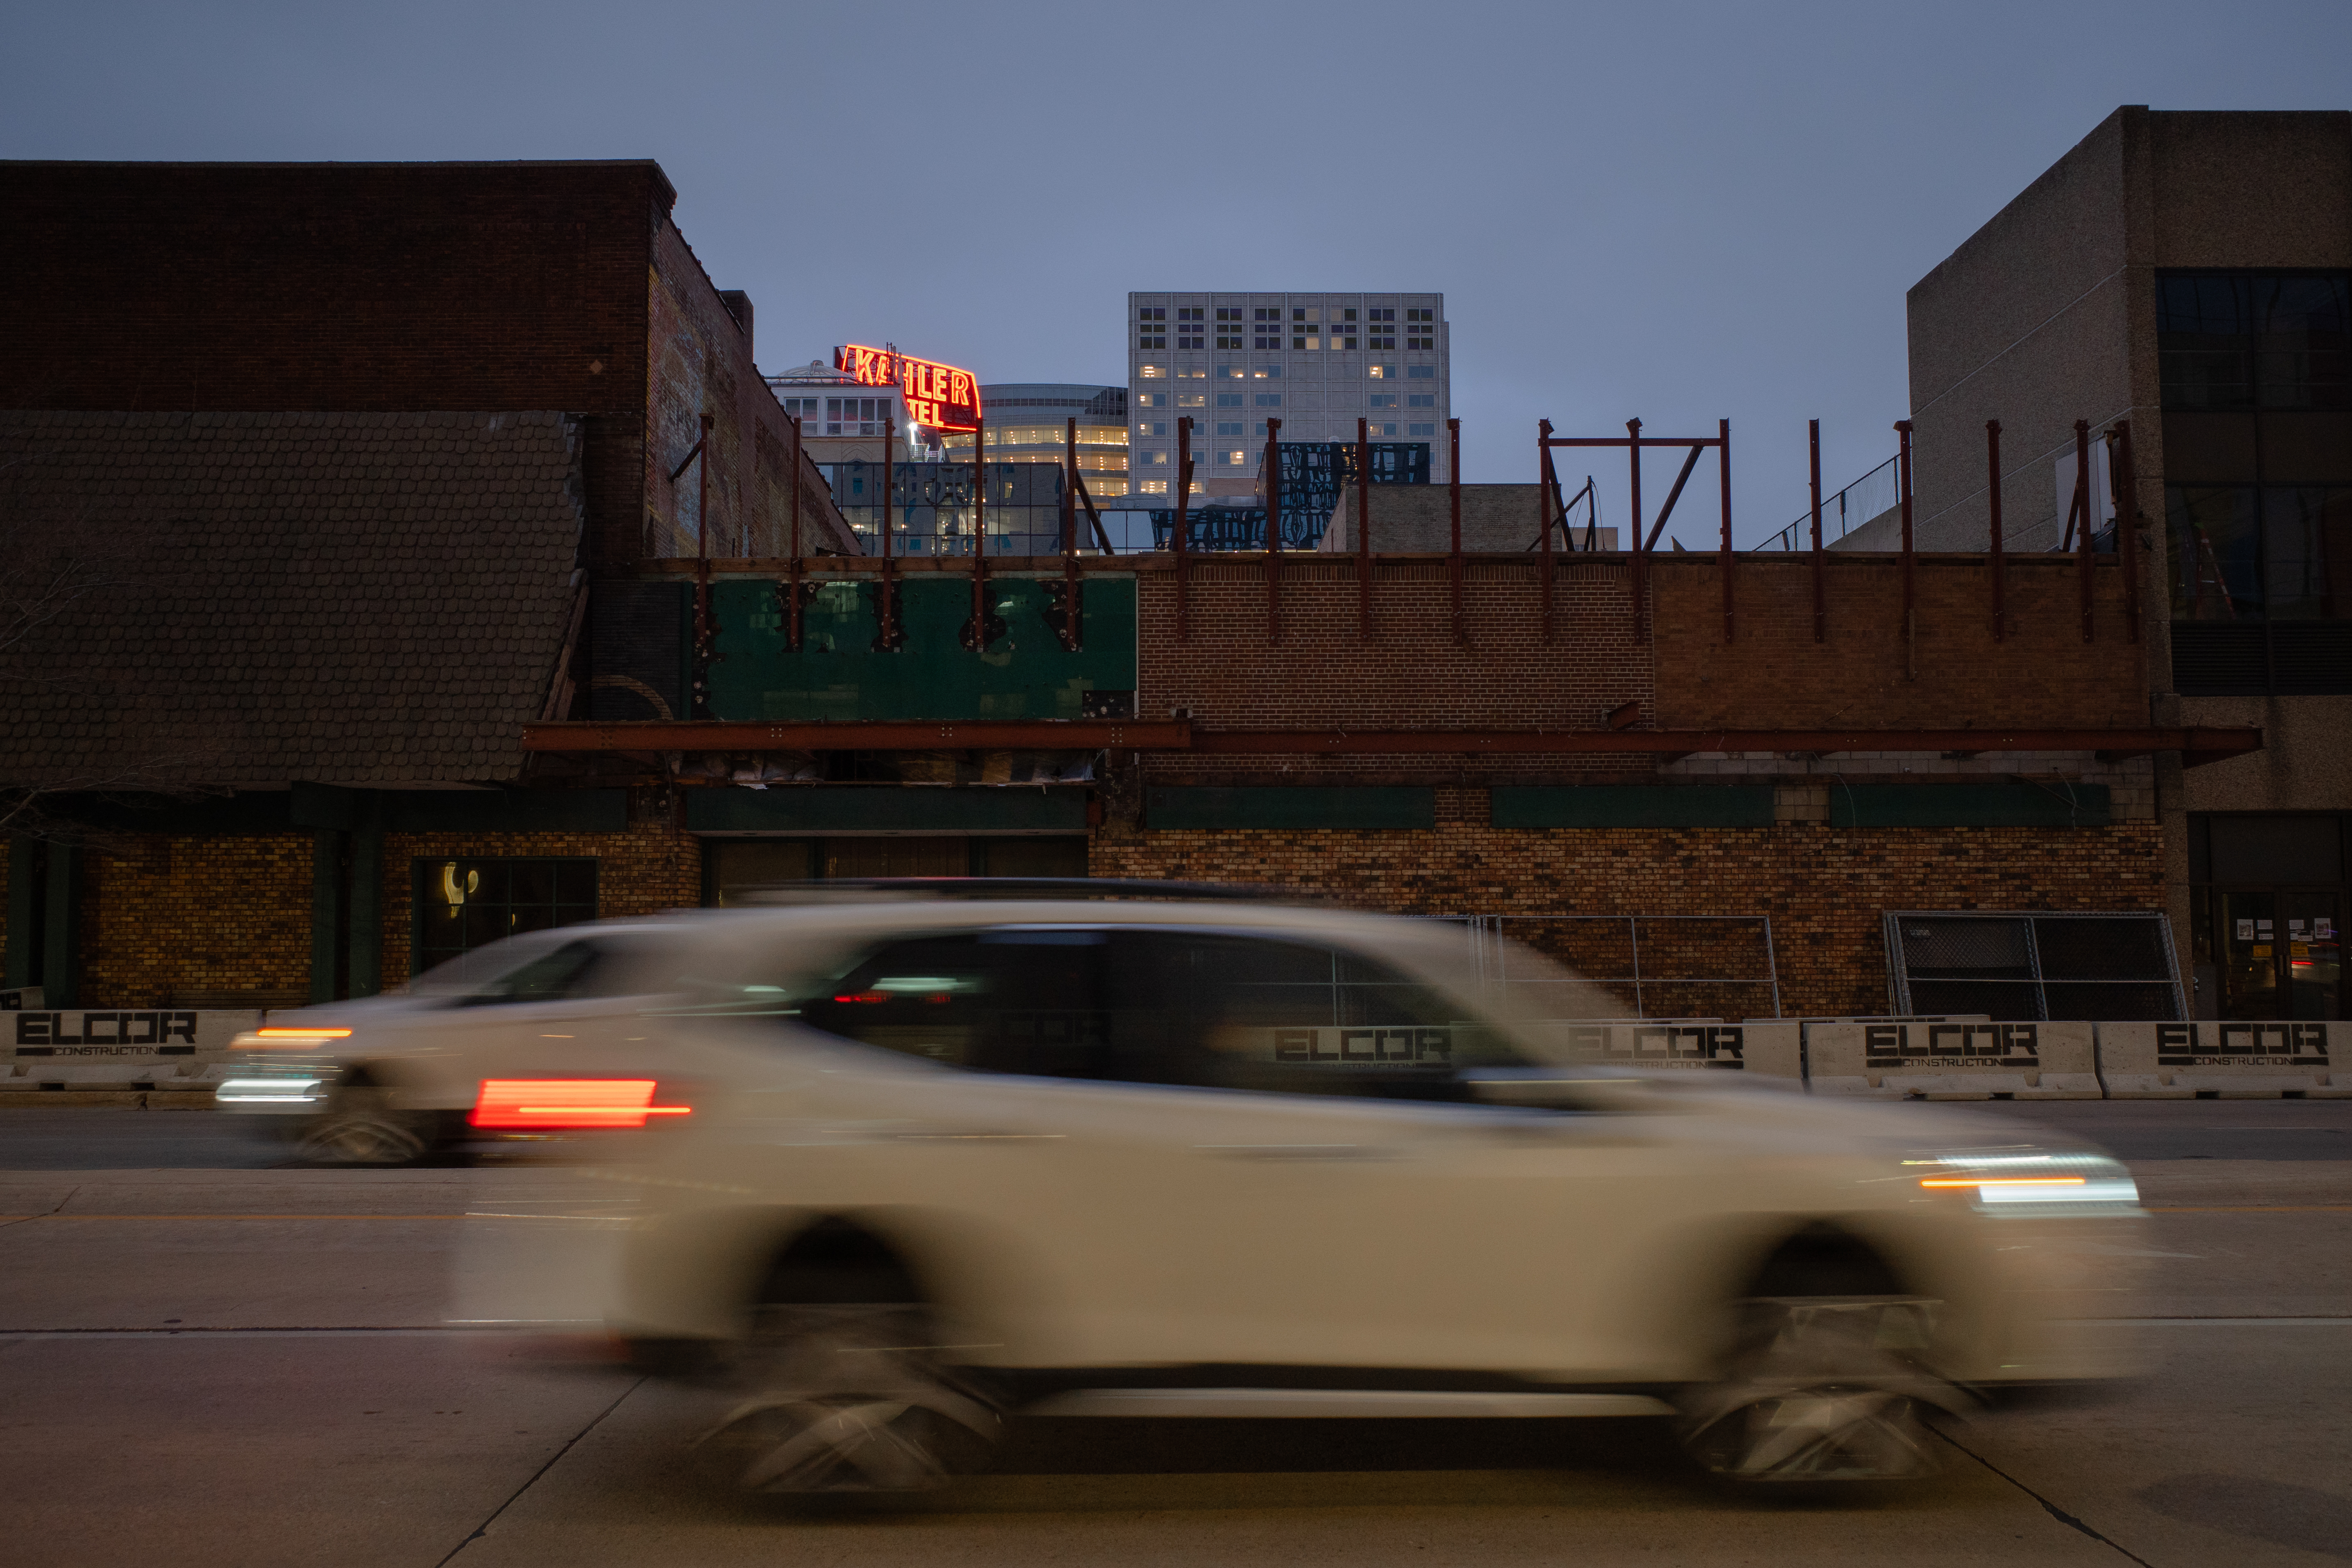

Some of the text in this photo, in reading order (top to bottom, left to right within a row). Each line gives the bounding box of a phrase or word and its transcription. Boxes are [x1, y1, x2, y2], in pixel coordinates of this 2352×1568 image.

[906, 398, 944, 425] TEL
[16, 1012, 197, 1044] ELCOR
[1568, 1027, 1744, 1059] ELCOR
[1865, 1024, 2038, 1056] ELCOR
[2156, 1023, 2328, 1055] ELCOR
[53, 1046, 159, 1056] CONSTRUCTION
[1275, 1029, 1452, 1061] ELCOR
[1902, 1058, 2004, 1067] CONSTRUCTION
[2193, 1057, 2293, 1066] CONSTRUCTION
